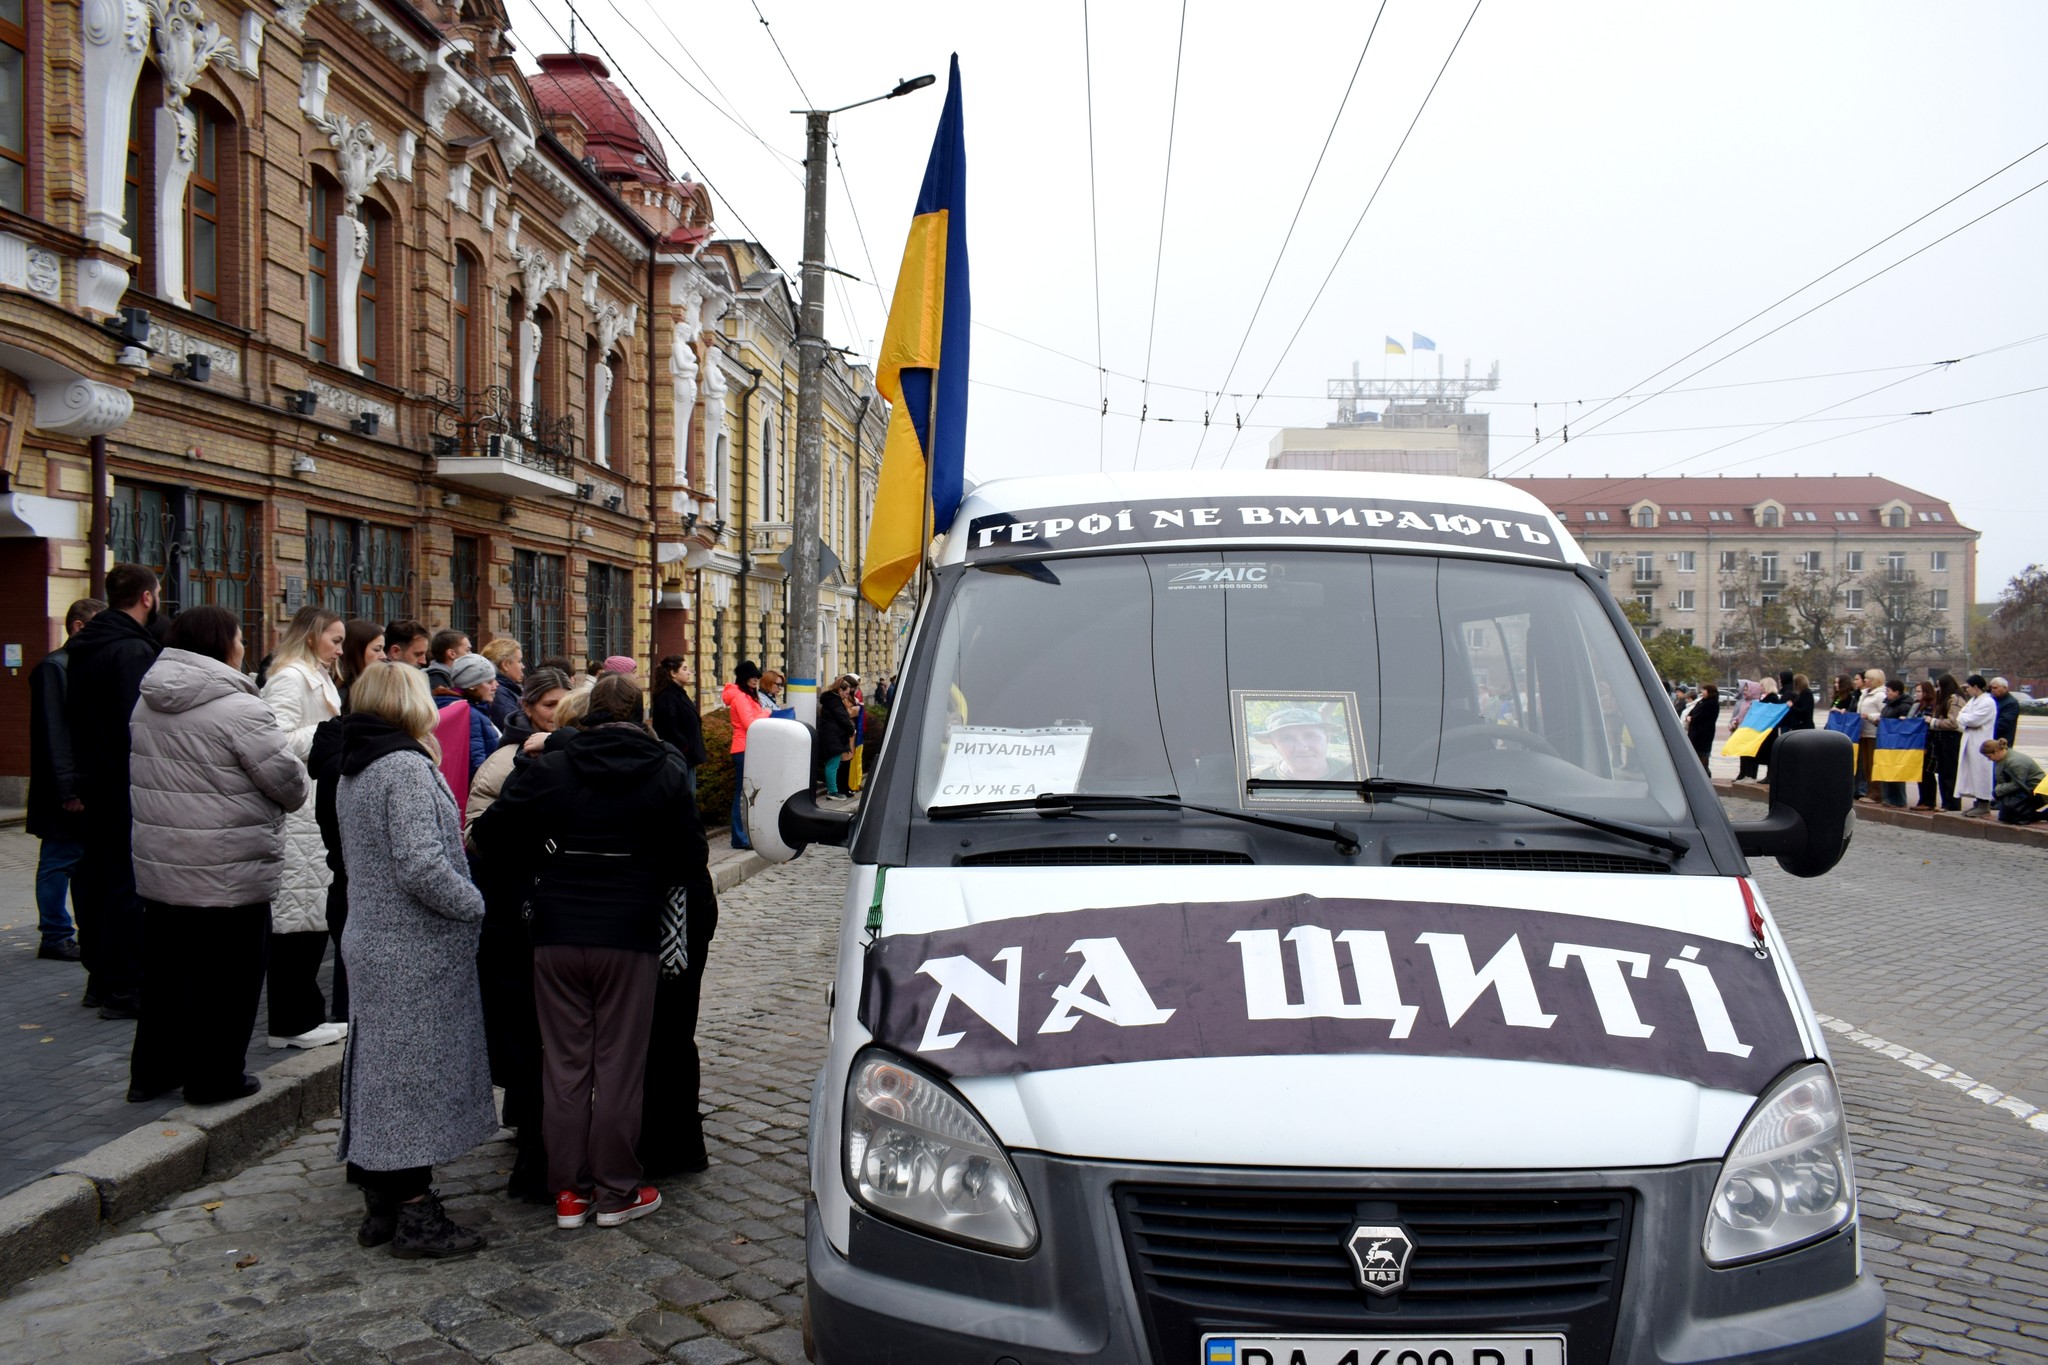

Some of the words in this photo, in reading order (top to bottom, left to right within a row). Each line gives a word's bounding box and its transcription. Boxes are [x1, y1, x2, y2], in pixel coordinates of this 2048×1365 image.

[977, 509, 1135, 548] ГЕРОЇ
[1237, 506, 1551, 545] ВМИРАЮТЬ
[953, 741, 1057, 757] РИТУАЛЬНА
[942, 783, 1037, 796] СЛУЖБА
[1226, 925, 1754, 1058] ЩИТІ
[1368, 1271, 1396, 1281] ГАЗ
